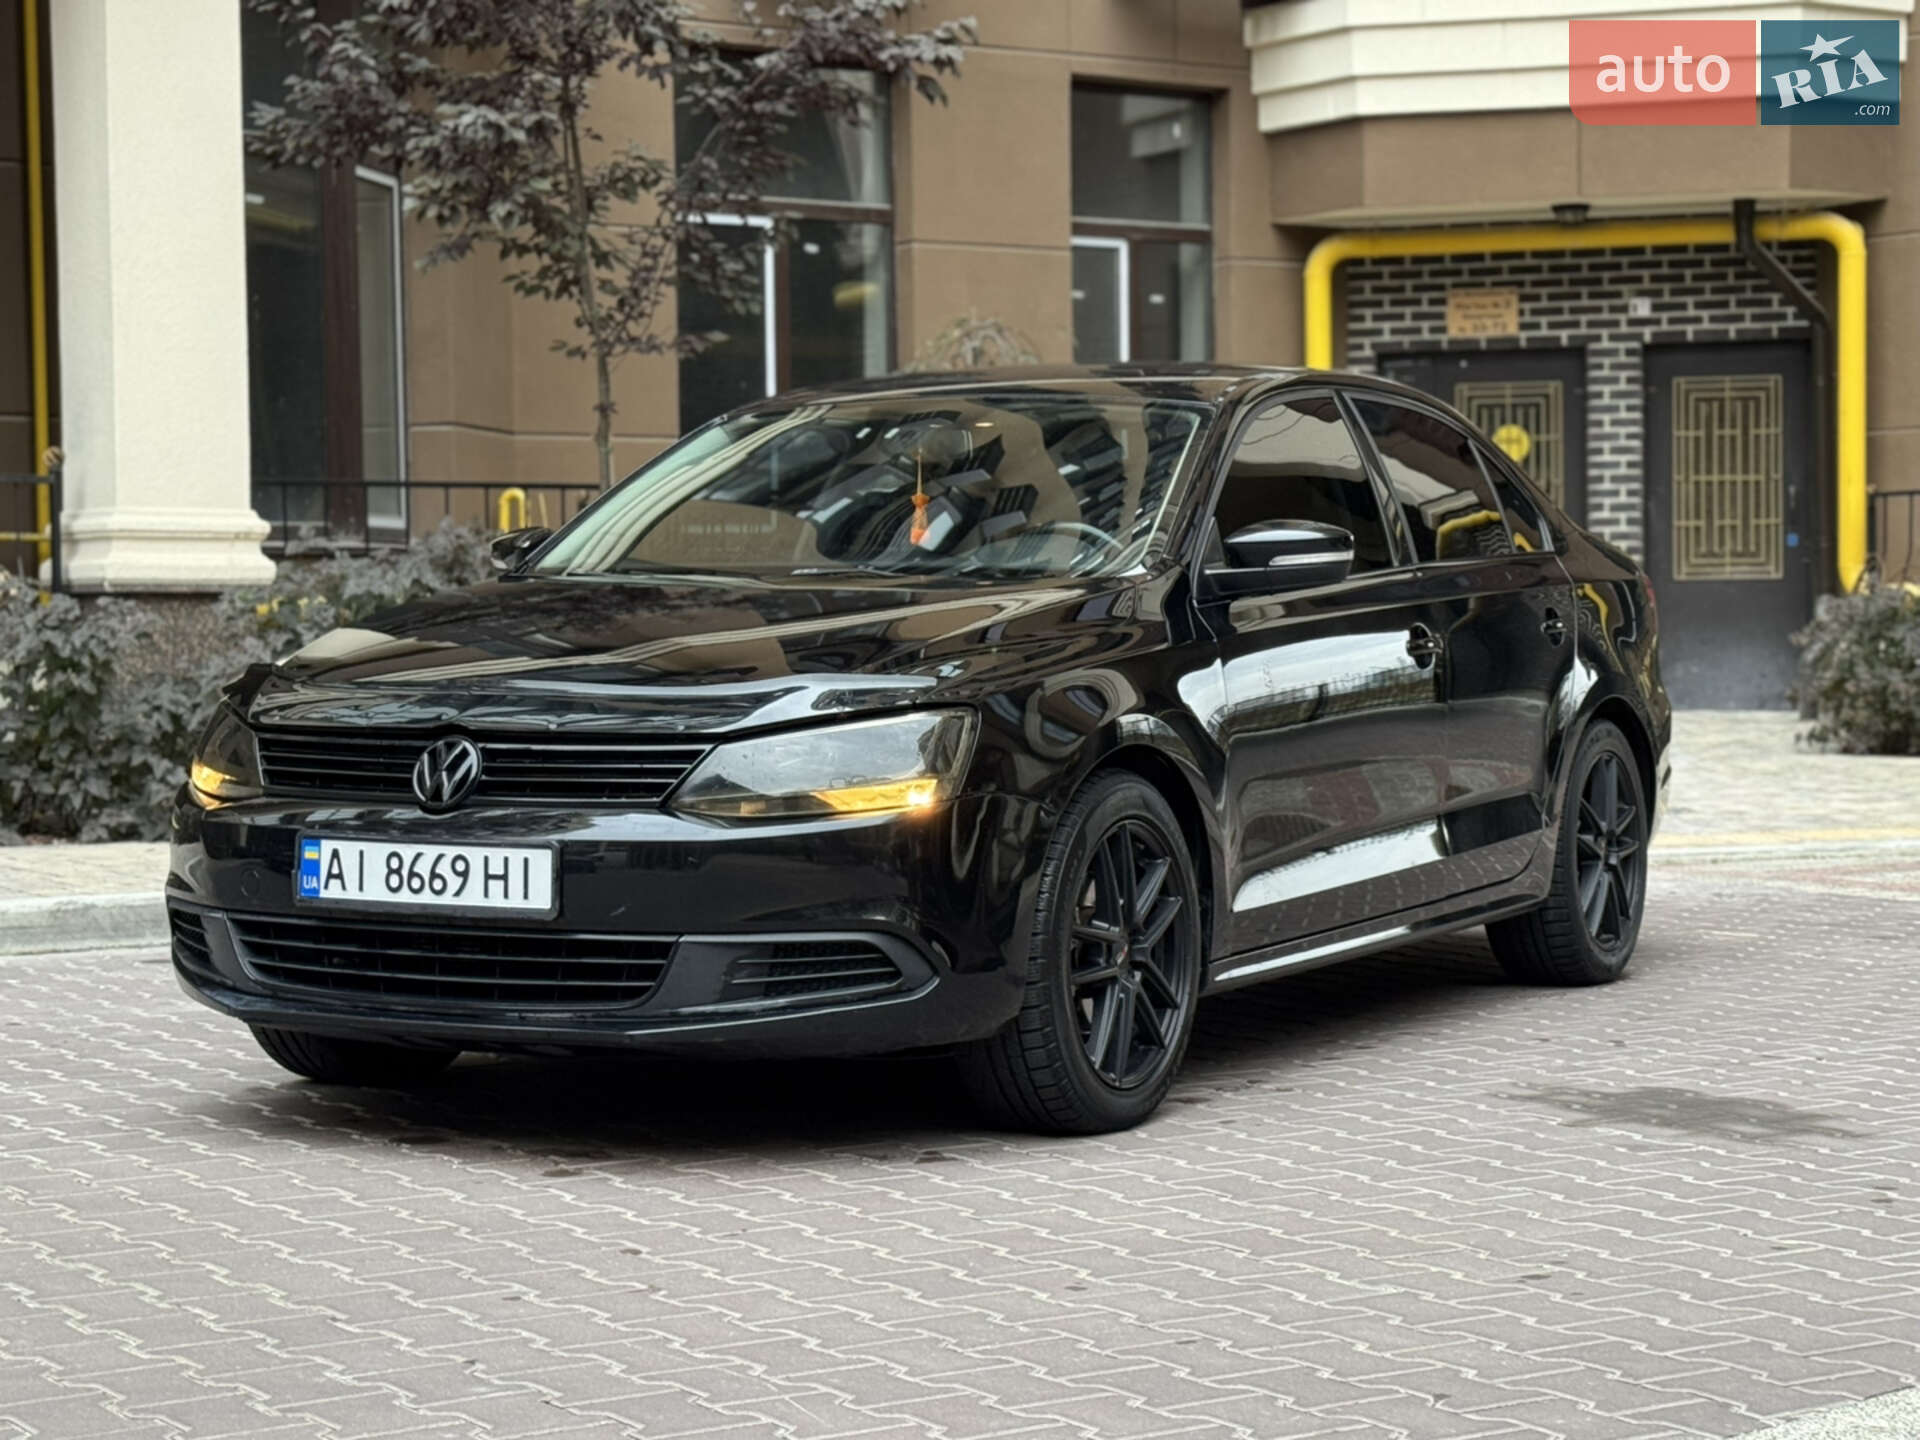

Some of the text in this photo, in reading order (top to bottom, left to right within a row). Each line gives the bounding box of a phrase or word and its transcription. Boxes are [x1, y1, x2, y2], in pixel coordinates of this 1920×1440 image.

[303, 875, 318, 889] UA
[323, 848, 530, 901] AI 8669 HI
